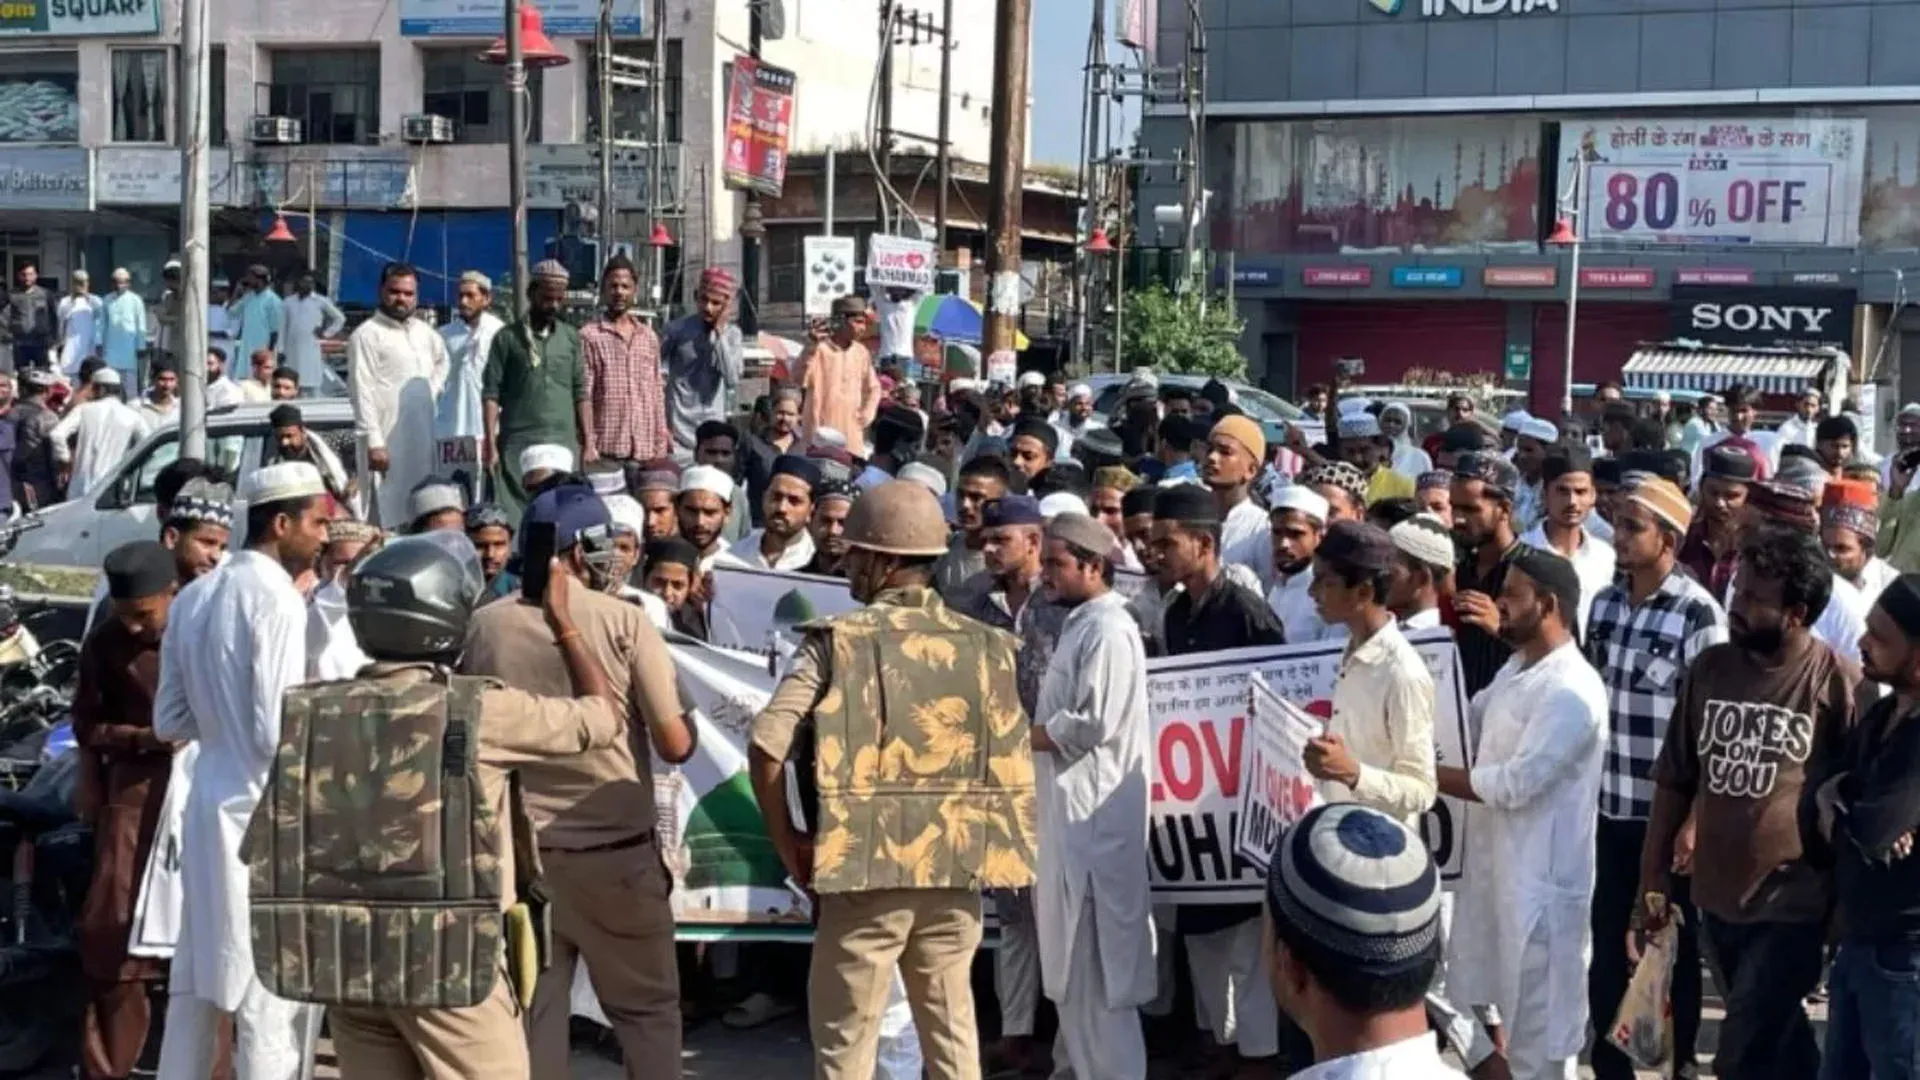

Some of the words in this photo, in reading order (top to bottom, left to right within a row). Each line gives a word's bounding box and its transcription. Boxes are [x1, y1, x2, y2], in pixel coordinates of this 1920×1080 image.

[1422, 0, 1559, 16] INDIA
[1605, 172, 1680, 231] 80
[1688, 198, 1717, 228] %
[1727, 180, 1807, 224] OFF
[880, 251, 906, 268] LOVE
[871, 267, 929, 284] MUHAMMAD
[1691, 302, 1832, 333] SONY
[1697, 699, 1813, 762] JOKES
[1726, 740, 1764, 766] ON
[1707, 754, 1778, 798] YOU
